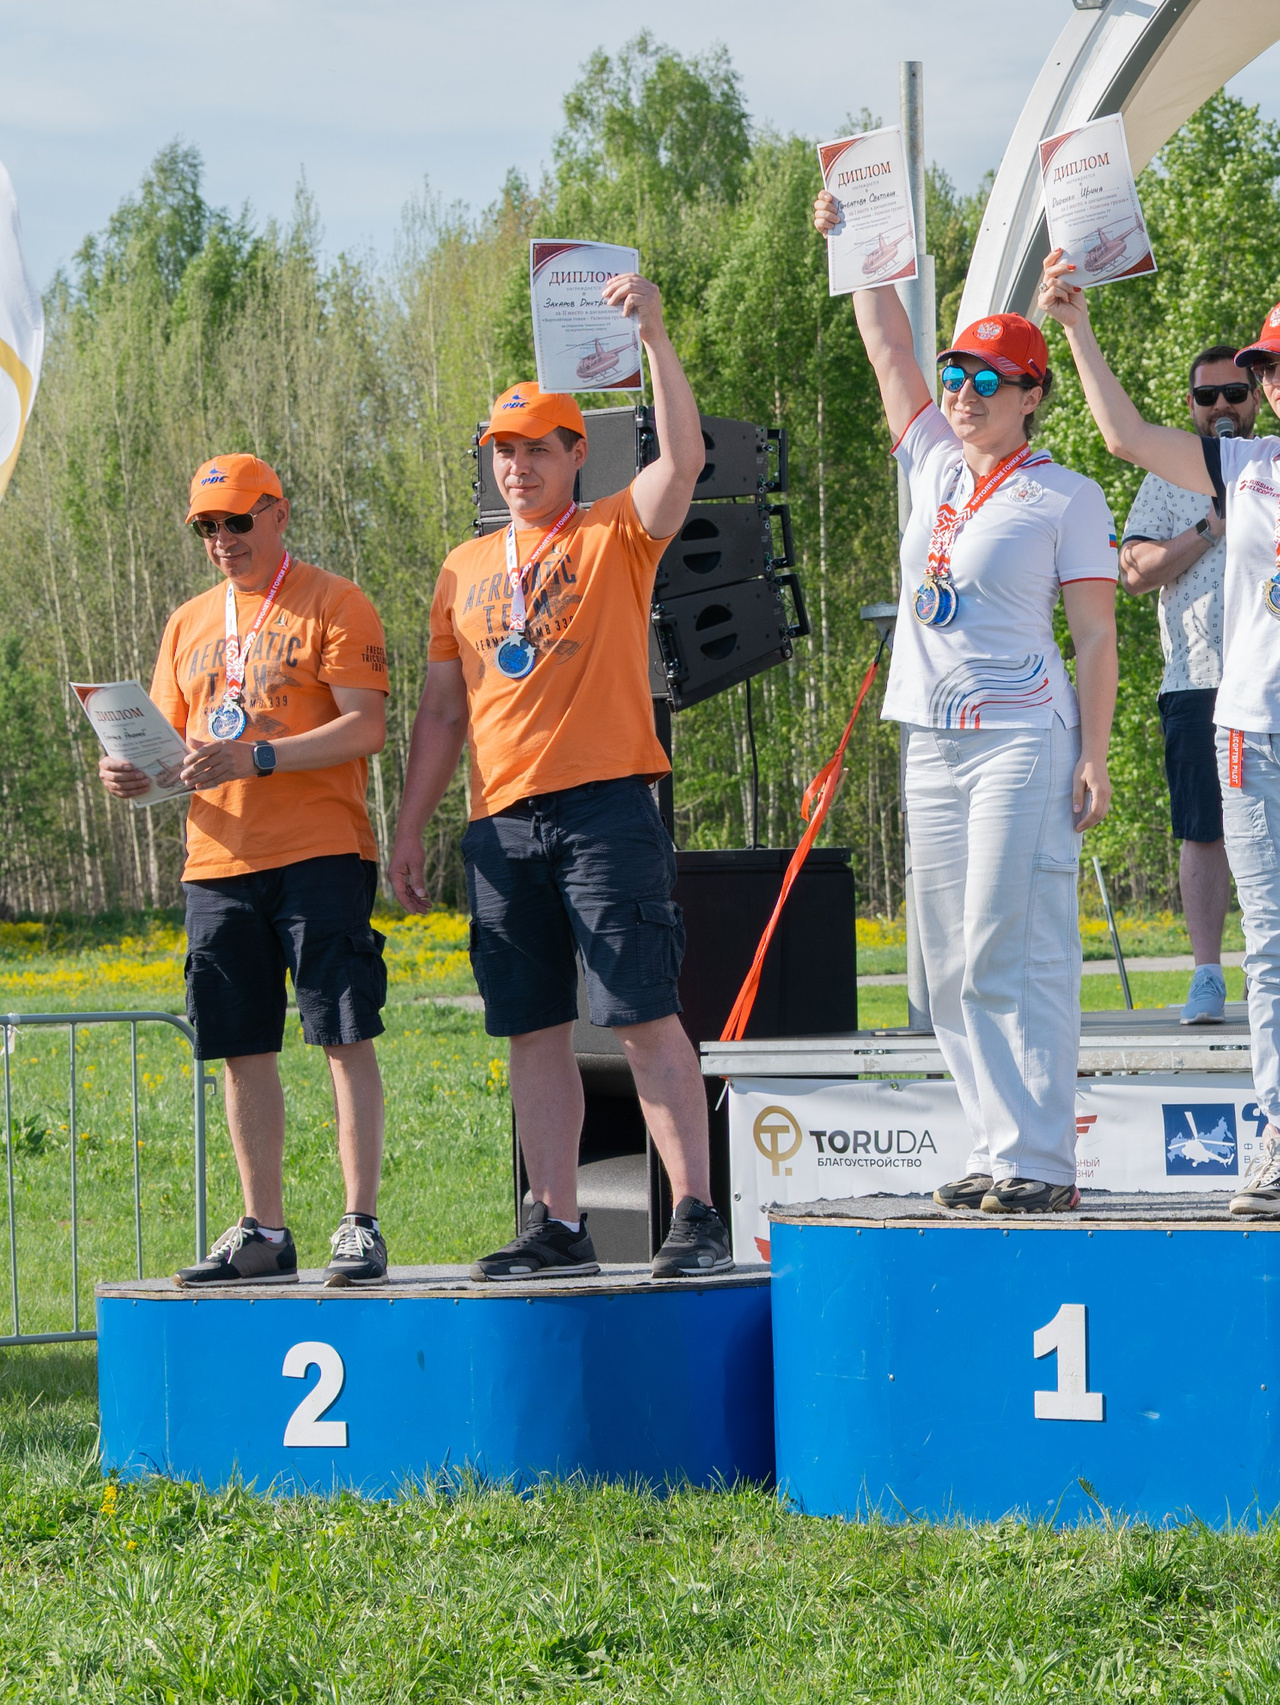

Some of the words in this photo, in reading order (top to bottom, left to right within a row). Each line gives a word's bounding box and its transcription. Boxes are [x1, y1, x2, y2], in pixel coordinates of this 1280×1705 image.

[838, 161, 892, 189] ДИПЛОМ
[1053, 152, 1110, 184] ДИПЛОМ
[1080, 186, 1104, 199] Ирина
[549, 271, 619, 286] ДИПЛОМ
[580, 297, 608, 311] Дмитри
[970, 468, 1005, 506] ВЕРТОЛЕТНЫЕ
[1002, 455, 1020, 473] ГОНКИ
[1247, 484, 1280, 498] HELICOPTER
[1249, 479, 1275, 492] RUSSIAN
[556, 511, 571, 531] ГОНКИ
[254, 590, 276, 630] ВЕРТОЛЕТНЫЕ
[273, 569, 286, 593] ГОНКИ
[483, 590, 553, 633] TEM
[189, 631, 301, 681] AERATIC
[207, 664, 267, 703] TM
[1232, 729, 1240, 763] ELICOPTER
[1231, 765, 1239, 784] PILOT
[809, 1129, 938, 1154] TORUDA
[817, 1156, 922, 1168] БЛАГОУСТРОЙСТВО
[1033, 1303, 1104, 1422] 1
[282, 1341, 349, 1448] 2
